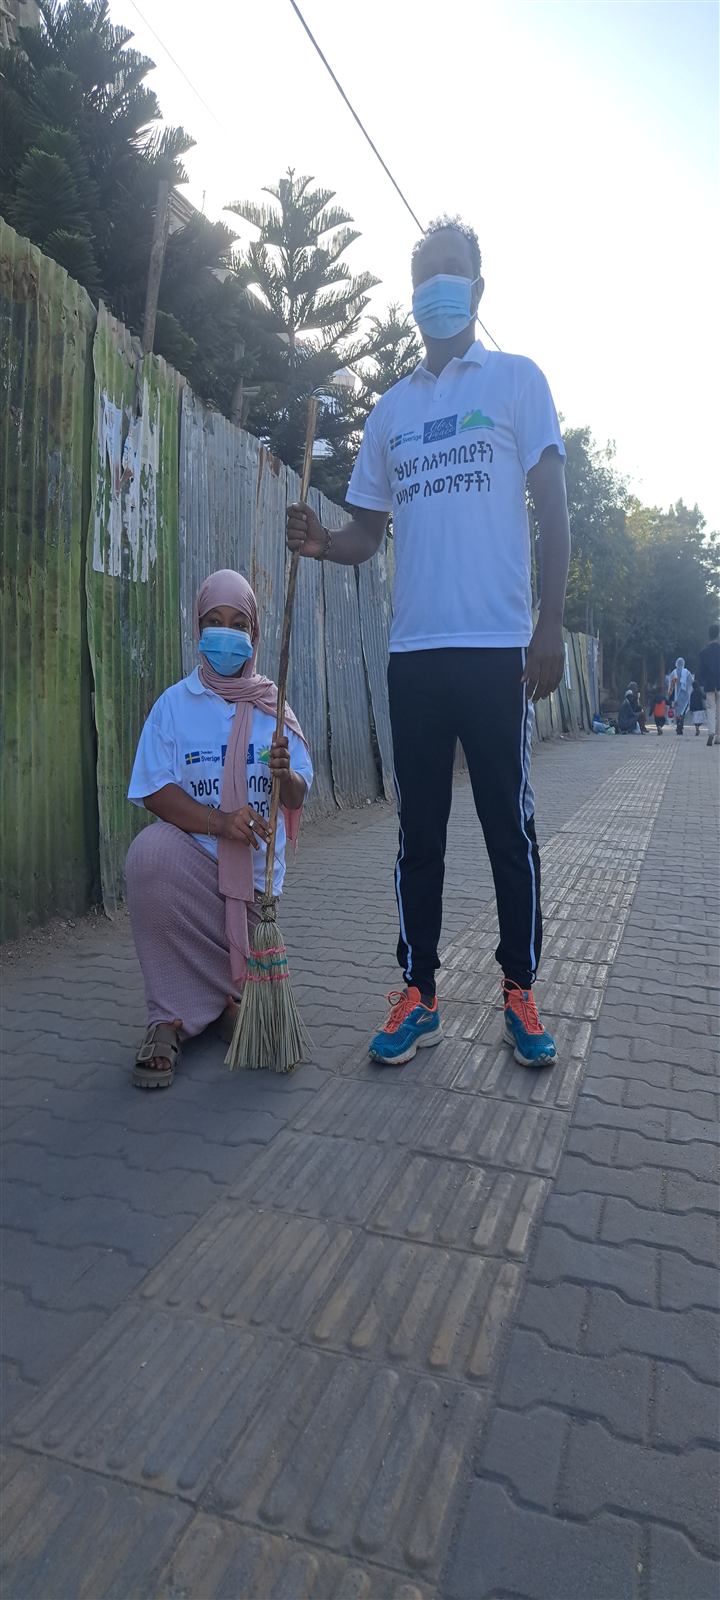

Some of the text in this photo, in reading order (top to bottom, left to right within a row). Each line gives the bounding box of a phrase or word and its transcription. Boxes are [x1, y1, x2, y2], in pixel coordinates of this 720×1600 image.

[402, 434, 422, 443] Sverige
[422, 441, 494, 472] ለአካባቢያችን
[424, 471, 490, 497] ለወገኖቻችን
[190, 778, 219, 797] ንፅህና
